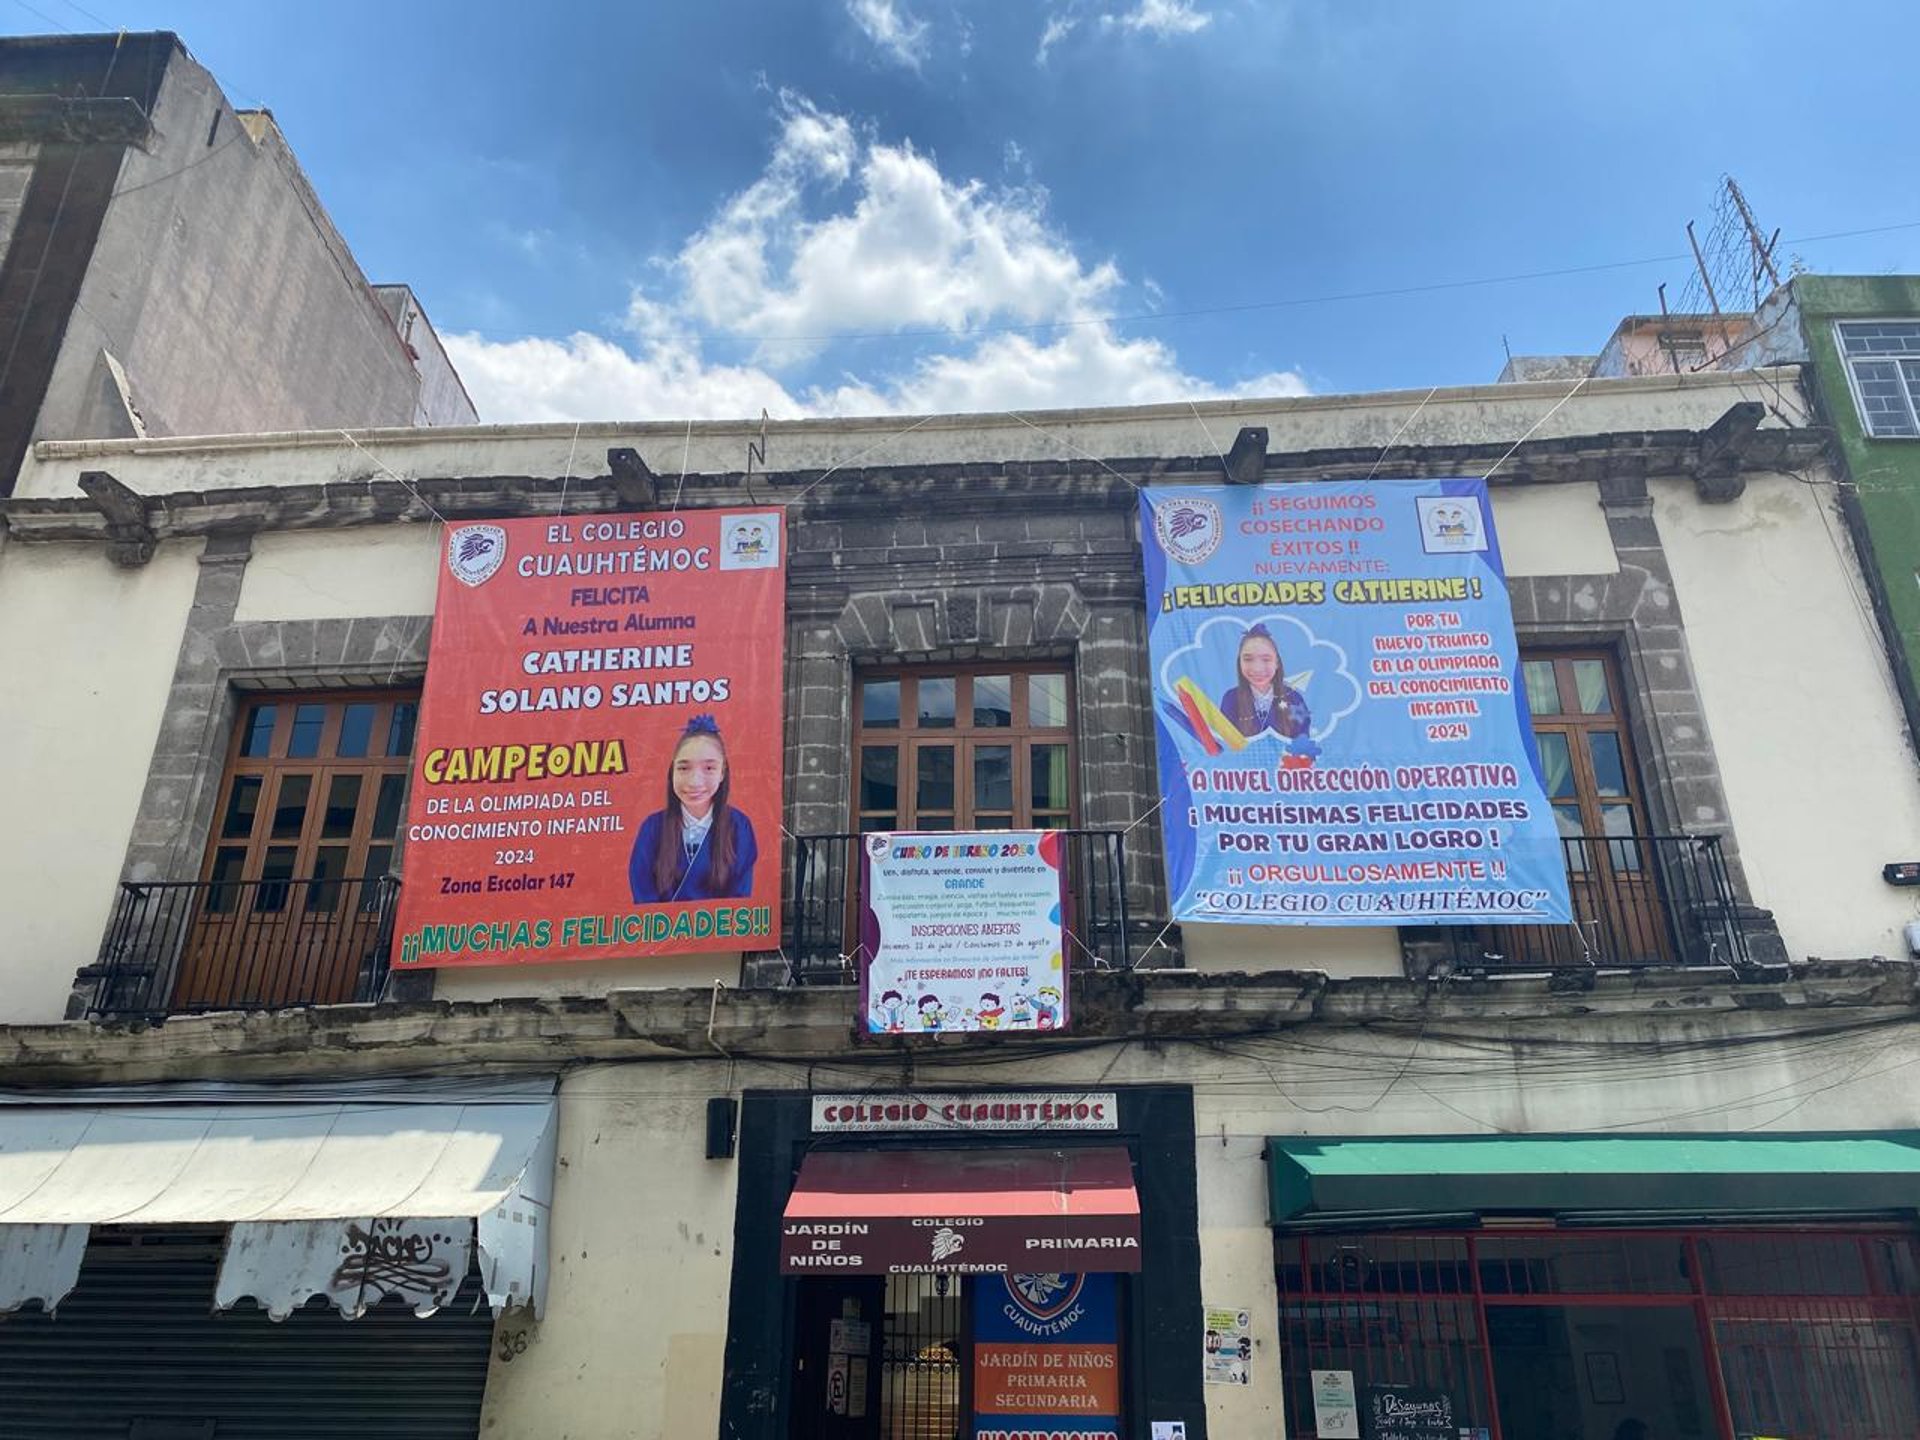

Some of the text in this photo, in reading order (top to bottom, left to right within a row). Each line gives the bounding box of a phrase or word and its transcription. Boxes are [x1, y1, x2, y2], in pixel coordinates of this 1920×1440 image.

[1268, 494, 1376, 513] SEGUIMOS
[547, 518, 686, 544] EL COLEGIO
[1240, 516, 1384, 535] COSECHANDO
[1270, 538, 1344, 557] ÉXITOS
[517, 544, 711, 578] CUAUHTÉMOC
[1254, 559, 1391, 576] NUEVAMENTE:
[571, 585, 650, 607] FELICITA
[1335, 577, 1467, 605] CATHERINE
[522, 611, 697, 636] A Nuestra Alumna
[1407, 612, 1460, 628] POR TU
[522, 643, 693, 675] CATHERINE
[1372, 655, 1501, 674] EN LA OLIMPIADA
[479, 677, 730, 715] SOLANO SANTOS
[1369, 677, 1510, 696] DEL CONOCIMIENTO
[1409, 700, 1479, 718] INFANTIL
[1428, 724, 1468, 740] 2024
[423, 738, 628, 785] CAMPEONA
[1192, 772, 1207, 789] A
[1213, 769, 1271, 793] NIVEL
[1395, 764, 1518, 789] OPERATIVA
[427, 790, 613, 815] DE LA OLIMPIADA DEL
[1204, 801, 1361, 825] MUCHÍSIMAS
[1368, 799, 1529, 823] FELICIDADES
[409, 815, 625, 841] CONOCIMIENTO INFANTIL
[1219, 833, 1270, 853] POR
[1280, 832, 1309, 852] TU
[1317, 831, 1389, 852] GRAN
[1396, 829, 1483, 850] LOGRO
[494, 849, 535, 865] 2024
[934, 846, 949, 858] DE
[1248, 860, 1485, 885] ORGULLOSAMENTE
[441, 872, 576, 895] Zona Escolar 147
[911, 924, 979, 937] INSCRIPCIONES
[824, 1103, 928, 1123] COLEGIO
[784, 1222, 869, 1236] JARDÍN
[911, 1217, 985, 1227] COLEGIO
[812, 1239, 841, 1251] DE
[1025, 1236, 1139, 1250] PRIMARIA
[789, 1252, 864, 1267] NIÑOS
[888, 1261, 1009, 1273] CUAUHTÉMOC
[1003, 1303, 1086, 1337] CUAUHTÉMOC
[980, 1351, 1114, 1369] JARDÍN DE NIÑOS
[1007, 1374, 1088, 1388] PRIMARIA
[995, 1393, 1099, 1409] SECUNDARIA
